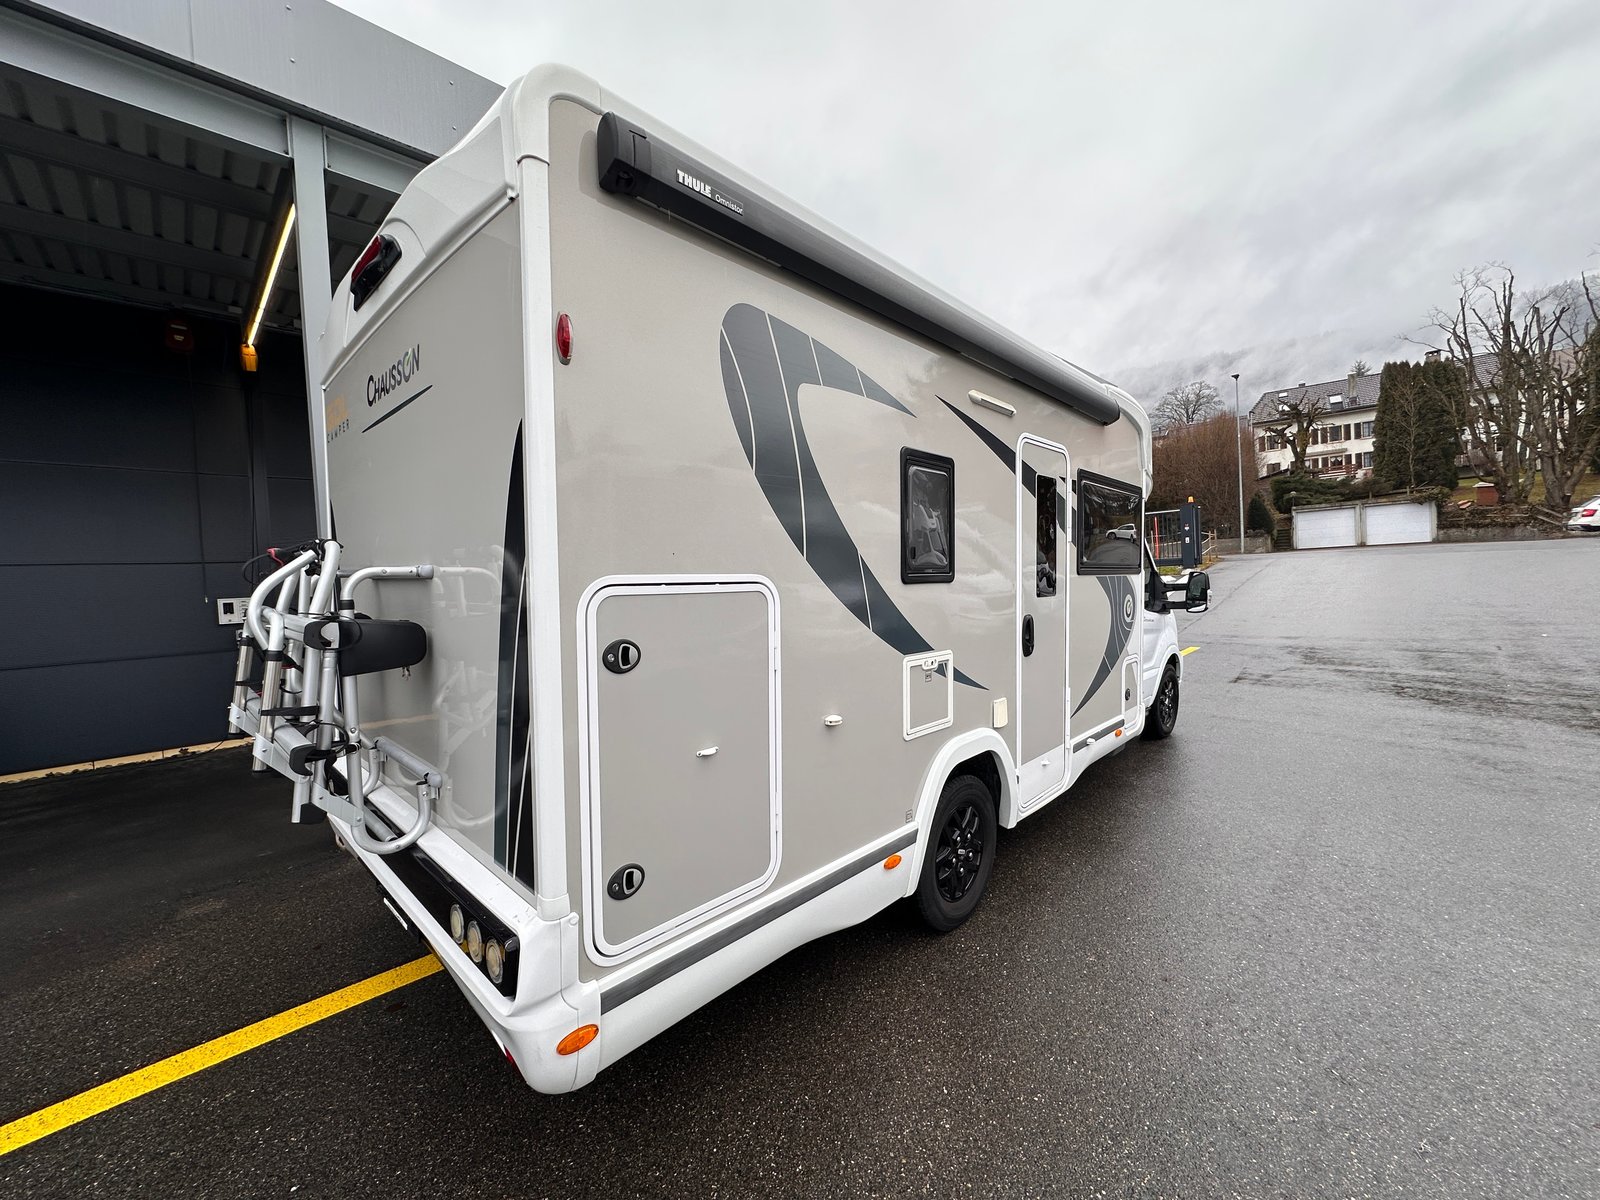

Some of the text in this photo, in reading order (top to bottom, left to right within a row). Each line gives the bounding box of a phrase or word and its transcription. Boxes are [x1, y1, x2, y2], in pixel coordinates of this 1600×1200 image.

[676, 168, 743, 214] THULE Omnistor
[366, 343, 420, 407] CHAUSSON
